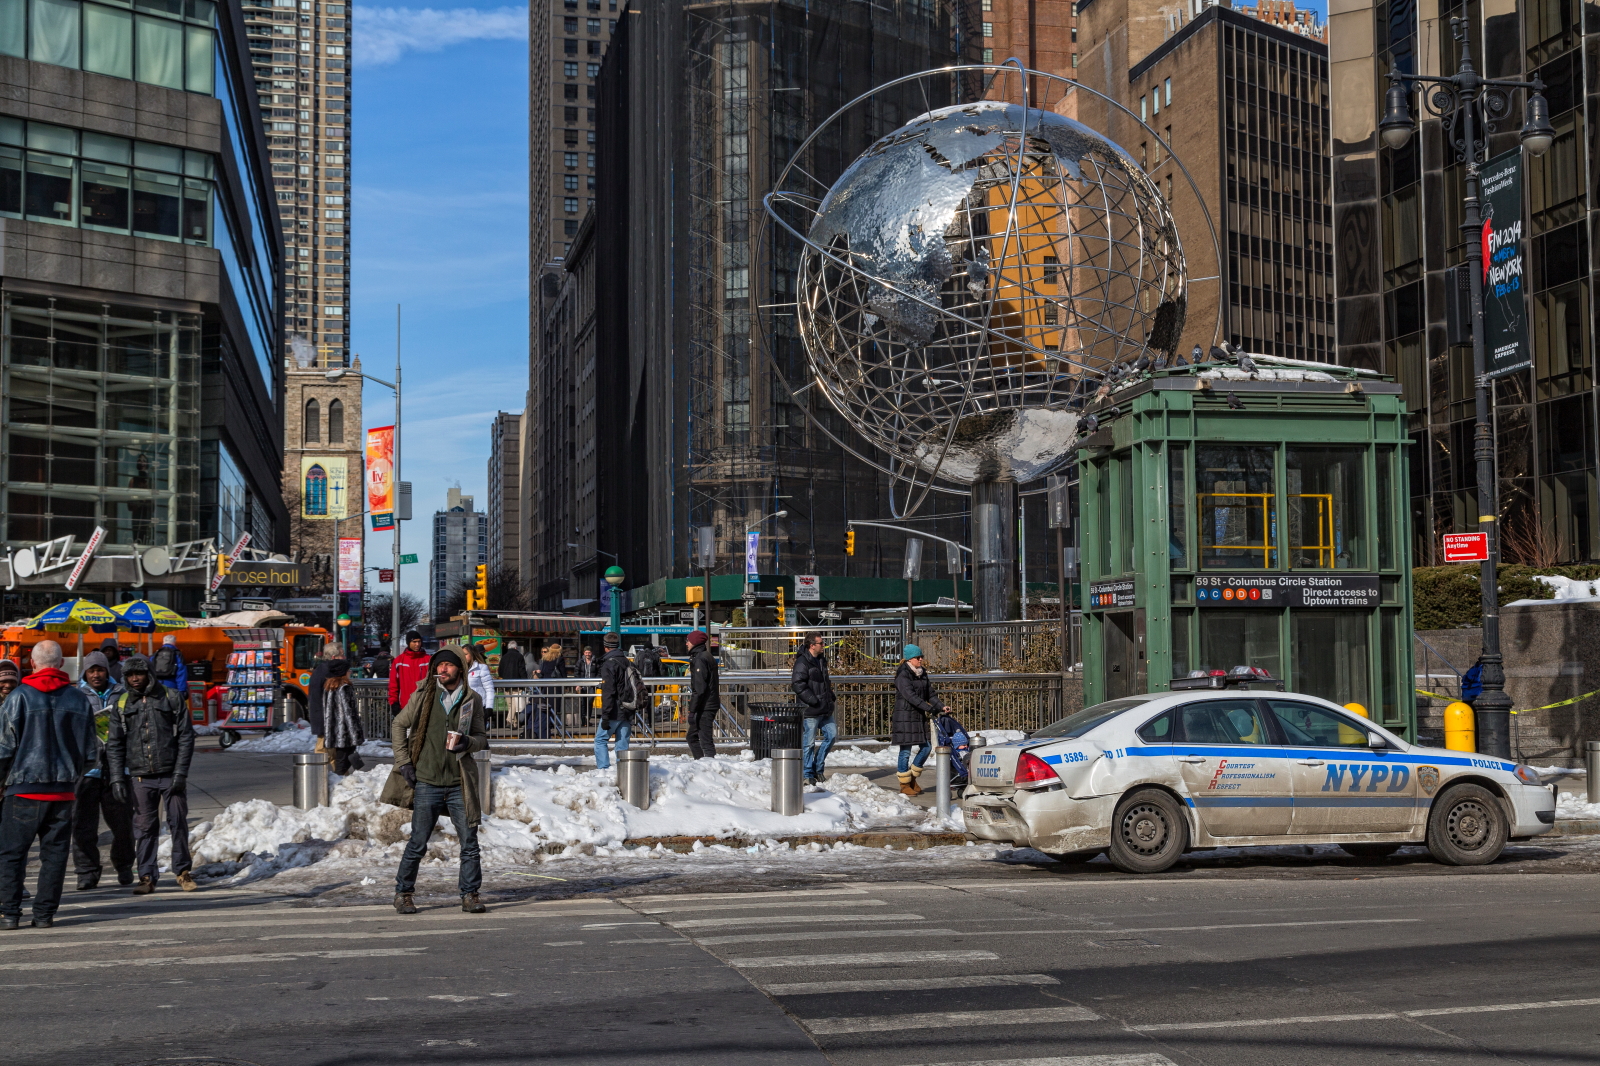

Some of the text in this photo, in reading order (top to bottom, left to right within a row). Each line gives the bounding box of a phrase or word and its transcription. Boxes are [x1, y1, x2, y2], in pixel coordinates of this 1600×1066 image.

[1481, 165, 1517, 187] Mercedes-Benz
[1488, 220, 1521, 253] F/W 2014
[1489, 255, 1522, 286] NEW YORK
[1495, 283, 1506, 298] FEB
[1494, 341, 1519, 353] AMERICAN
[1494, 349, 1515, 360] EXPRESS
[68, 530, 101, 587] at lincoln center
[210, 580, 219, 590] at
[232, 534, 250, 558] center
[230, 568, 299, 584] rose hall
[1196, 578, 1208, 586] 59
[1211, 578, 1221, 586] St
[1228, 578, 1277, 586] Columbus
[1278, 578, 1306, 586] Circle
[1308, 578, 1342, 586] Station
[1303, 588, 1378, 597] Direct access to
[1303, 597, 1368, 606] Uptown trains
[979, 754, 997, 764] NYPD
[1063, 751, 1084, 763] 3589
[1219, 759, 1255, 769] COURTESY
[1472, 758, 1501, 770] POLICE
[976, 767, 999, 778] POLICE
[1213, 769, 1276, 779] PROFESSIONALISM
[1321, 764, 1411, 793] NYPD
[1207, 780, 1241, 790] RESPECT
